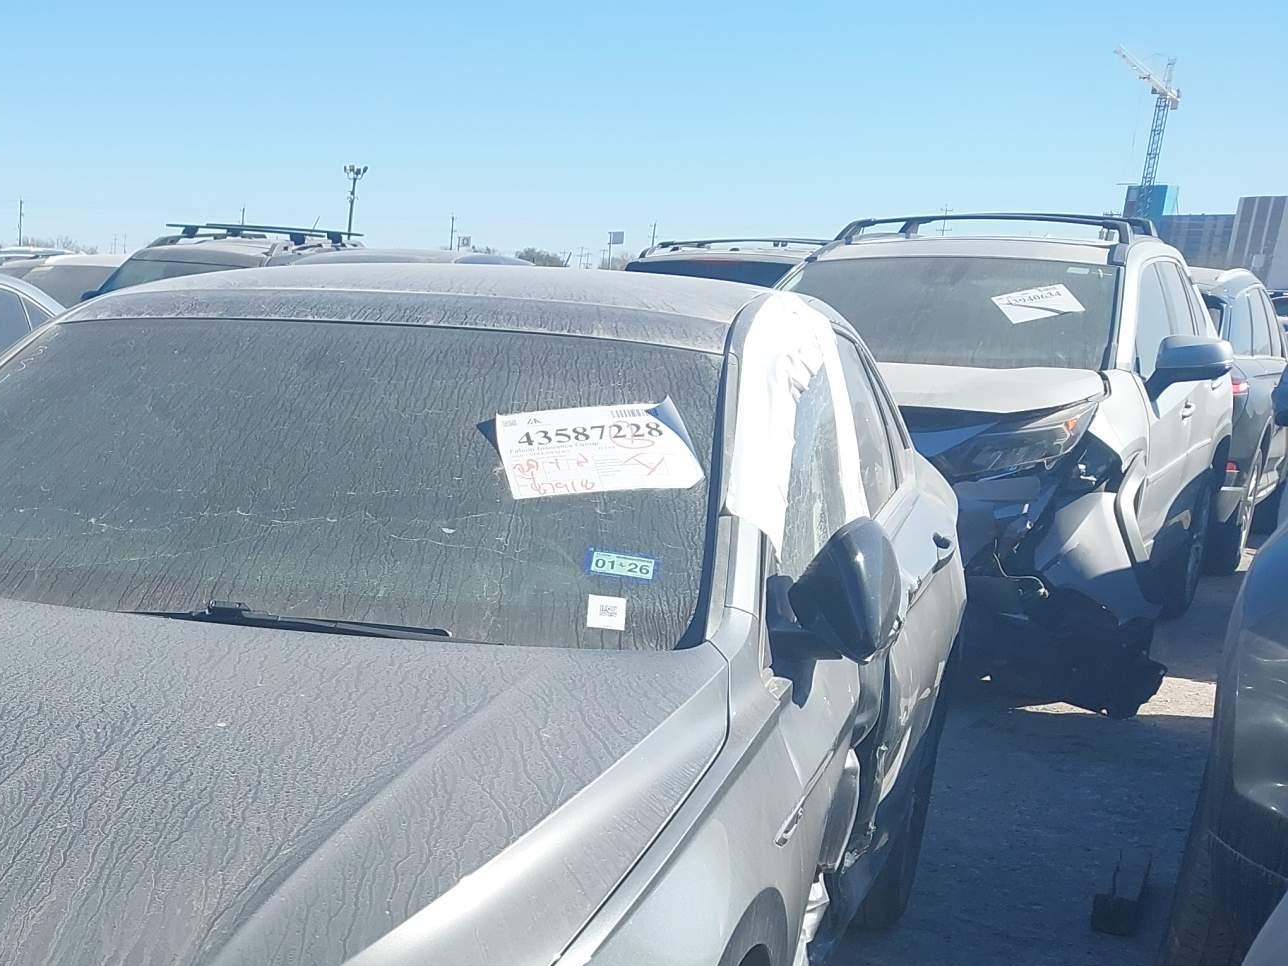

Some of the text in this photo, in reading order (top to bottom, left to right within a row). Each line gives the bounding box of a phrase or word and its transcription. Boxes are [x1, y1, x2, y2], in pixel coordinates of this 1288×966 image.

[517, 421, 663, 446] 43587228
[594, 558, 616, 570] 01
[627, 562, 650, 576] 26
